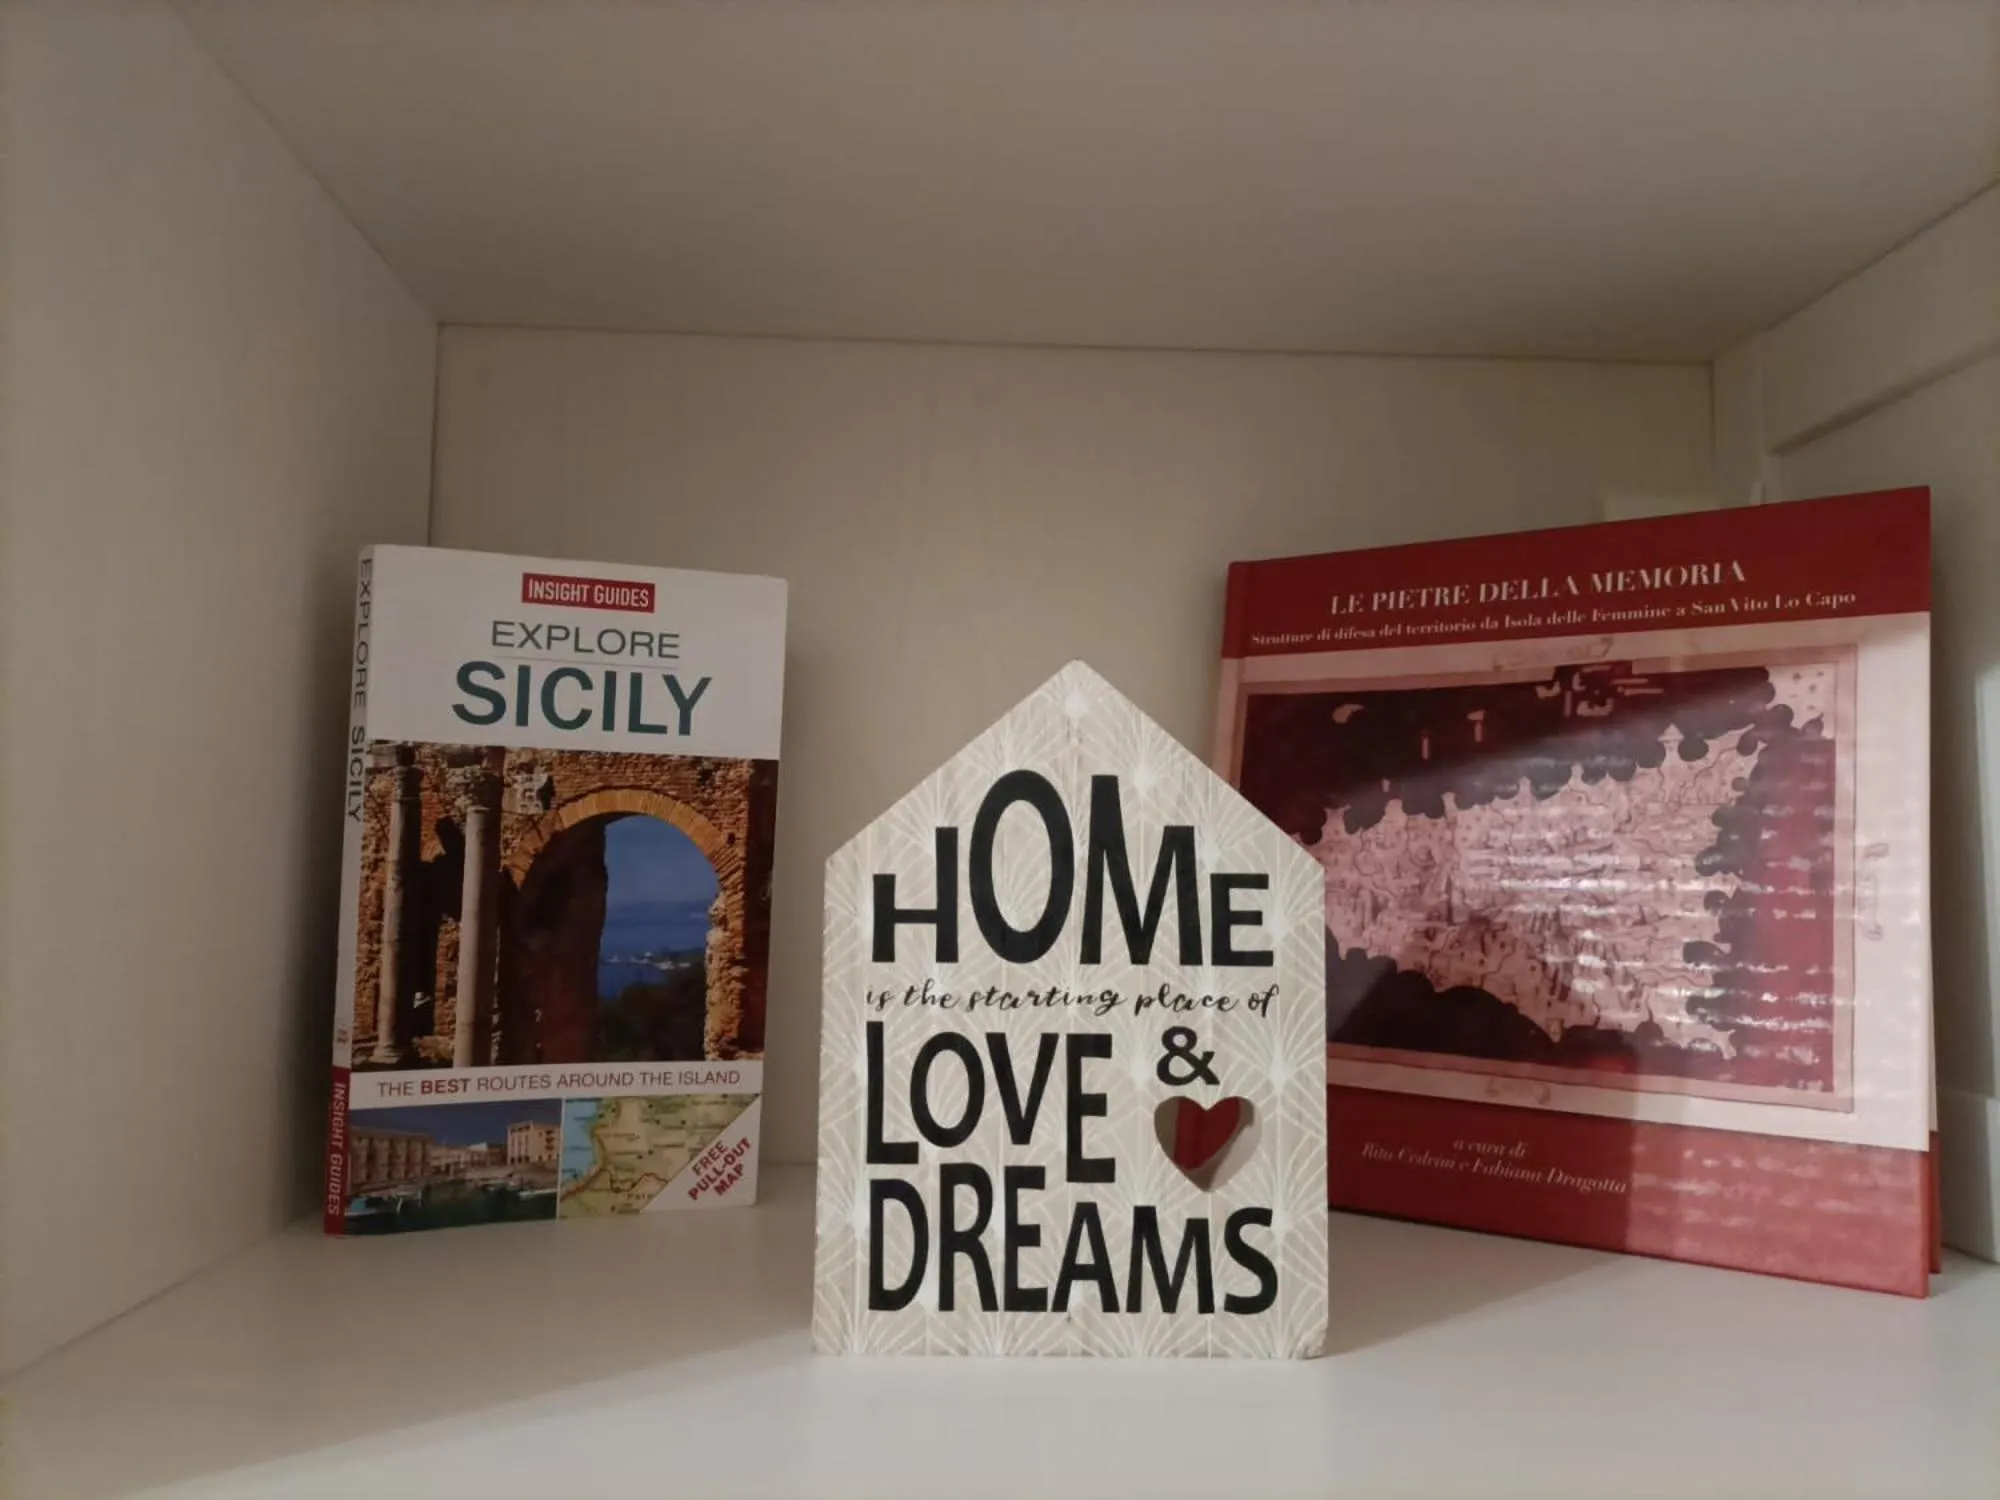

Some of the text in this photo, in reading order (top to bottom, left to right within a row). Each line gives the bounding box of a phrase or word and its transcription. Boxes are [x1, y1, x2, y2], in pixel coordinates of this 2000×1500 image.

[528, 578, 649, 607] INSIGHT GUIDES
[1331, 559, 1748, 616] LE PIETRE DELLA MEMORIA
[492, 620, 680, 659] EXPLORE
[1252, 631, 1314, 646] Strutture
[1317, 628, 1332, 641] di
[1334, 626, 1376, 641] difesa
[1379, 623, 1402, 638] del
[1406, 619, 1476, 637] territorio
[1480, 616, 1499, 630] da
[1504, 614, 1542, 629] Isola
[1546, 611, 1586, 625] delle
[1592, 607, 1672, 622] Femmine
[1675, 608, 1686, 617] a
[1774, 593, 1800, 609] Lo
[1805, 591, 1857, 610] Capo
[348, 557, 374, 822] EXPLORE SICILY
[452, 661, 713, 737] SICILY
[872, 769, 1274, 967] HOME
[866, 978, 1280, 1018] is the starting place of
[377, 1069, 741, 1097] THE BEST ROUTES AROUND THE ISLAND
[866, 1021, 1220, 1184] LOVE &
[328, 1082, 346, 1216] INSIGHT GUIDES
[687, 1136, 752, 1201] PULL-OUT
[692, 1139, 729, 1176] FREE
[1452, 1139, 1529, 1158] a cura di
[713, 1163, 744, 1196] MAP
[868, 1162, 1279, 1315] DREAMS
